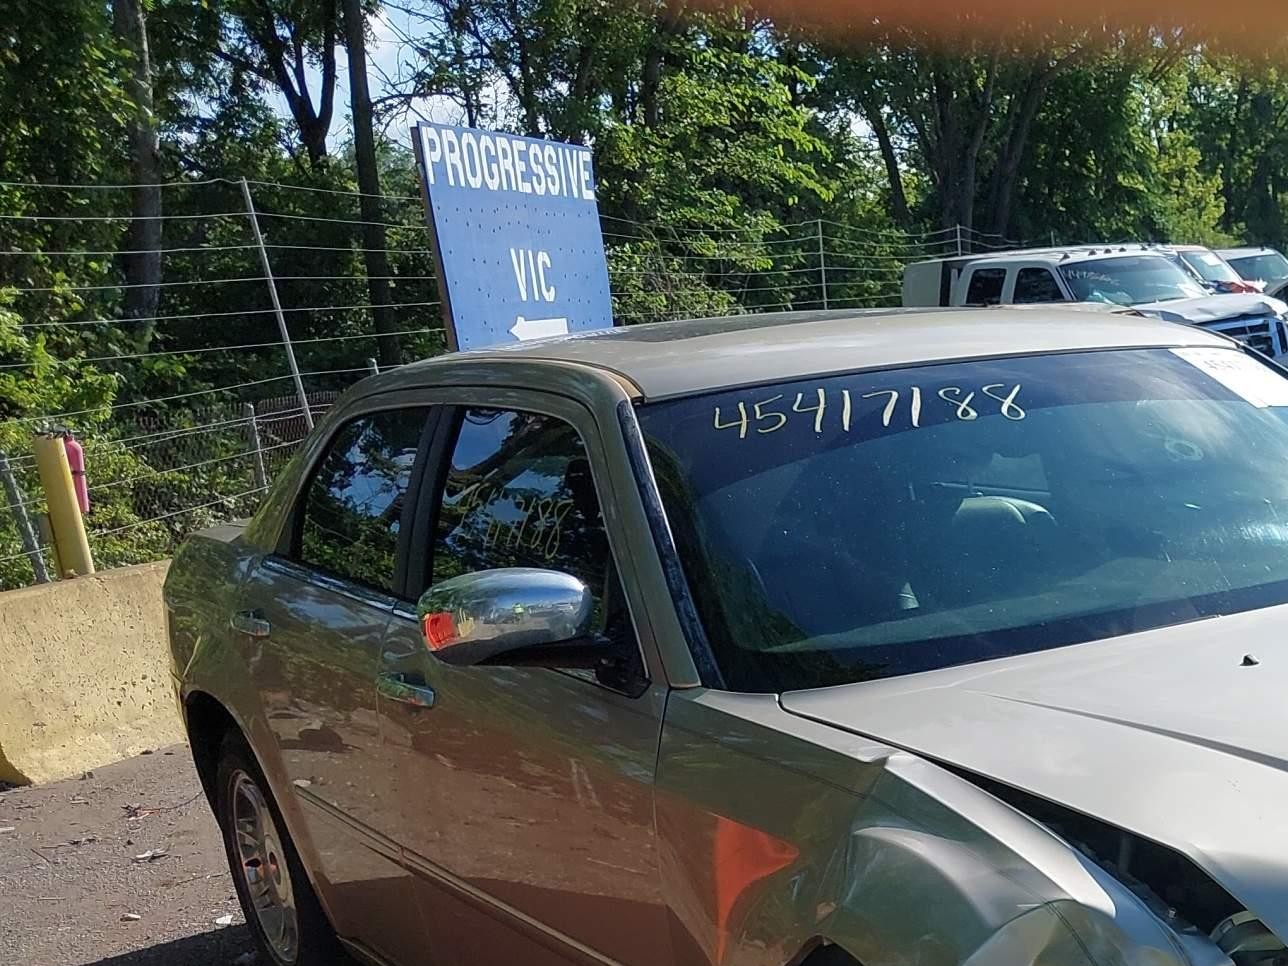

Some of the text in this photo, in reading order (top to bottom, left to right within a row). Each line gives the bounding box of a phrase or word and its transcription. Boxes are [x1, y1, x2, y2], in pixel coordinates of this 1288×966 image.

[421, 126, 595, 199] PROGRESSIVE
[510, 248, 555, 302] VIC
[714, 383, 1026, 439] 45417188
